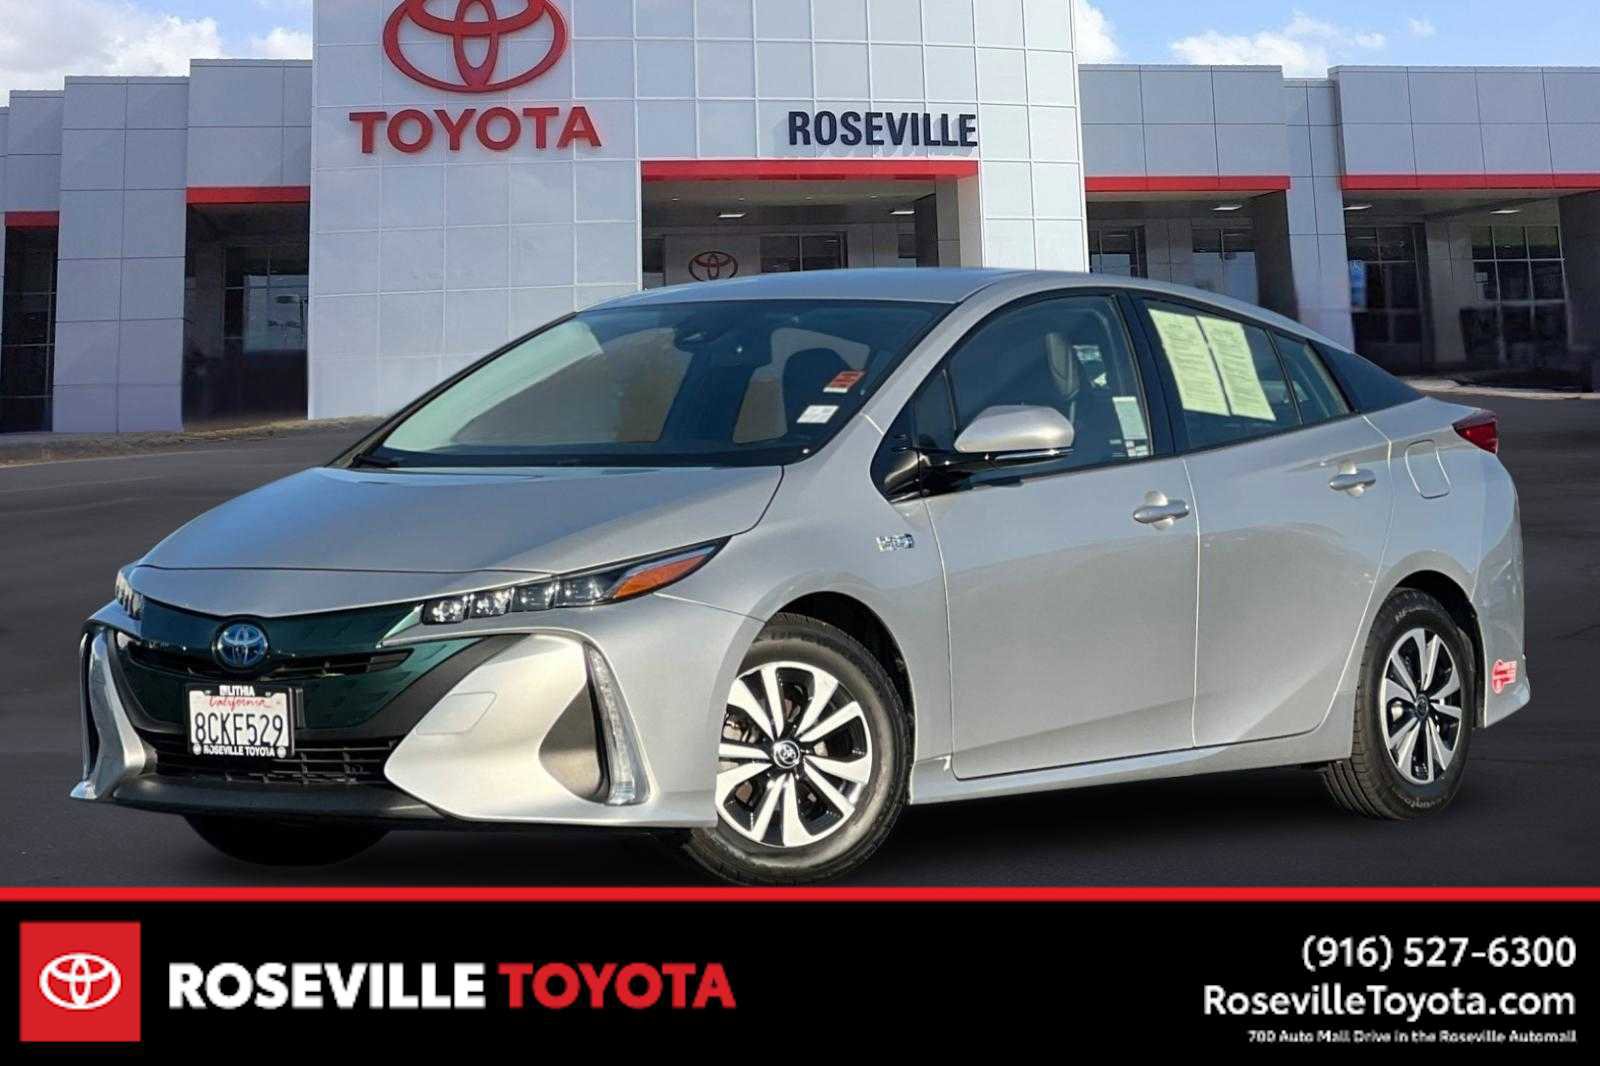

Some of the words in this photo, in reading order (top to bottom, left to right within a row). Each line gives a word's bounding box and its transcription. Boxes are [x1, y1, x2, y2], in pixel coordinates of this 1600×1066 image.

[350, 106, 602, 154] TOYOTA
[788, 110, 978, 147] ROSEVILLE
[209, 695, 272, 712] California
[228, 685, 256, 697] LITHIA
[194, 712, 284, 747] 8CKF529
